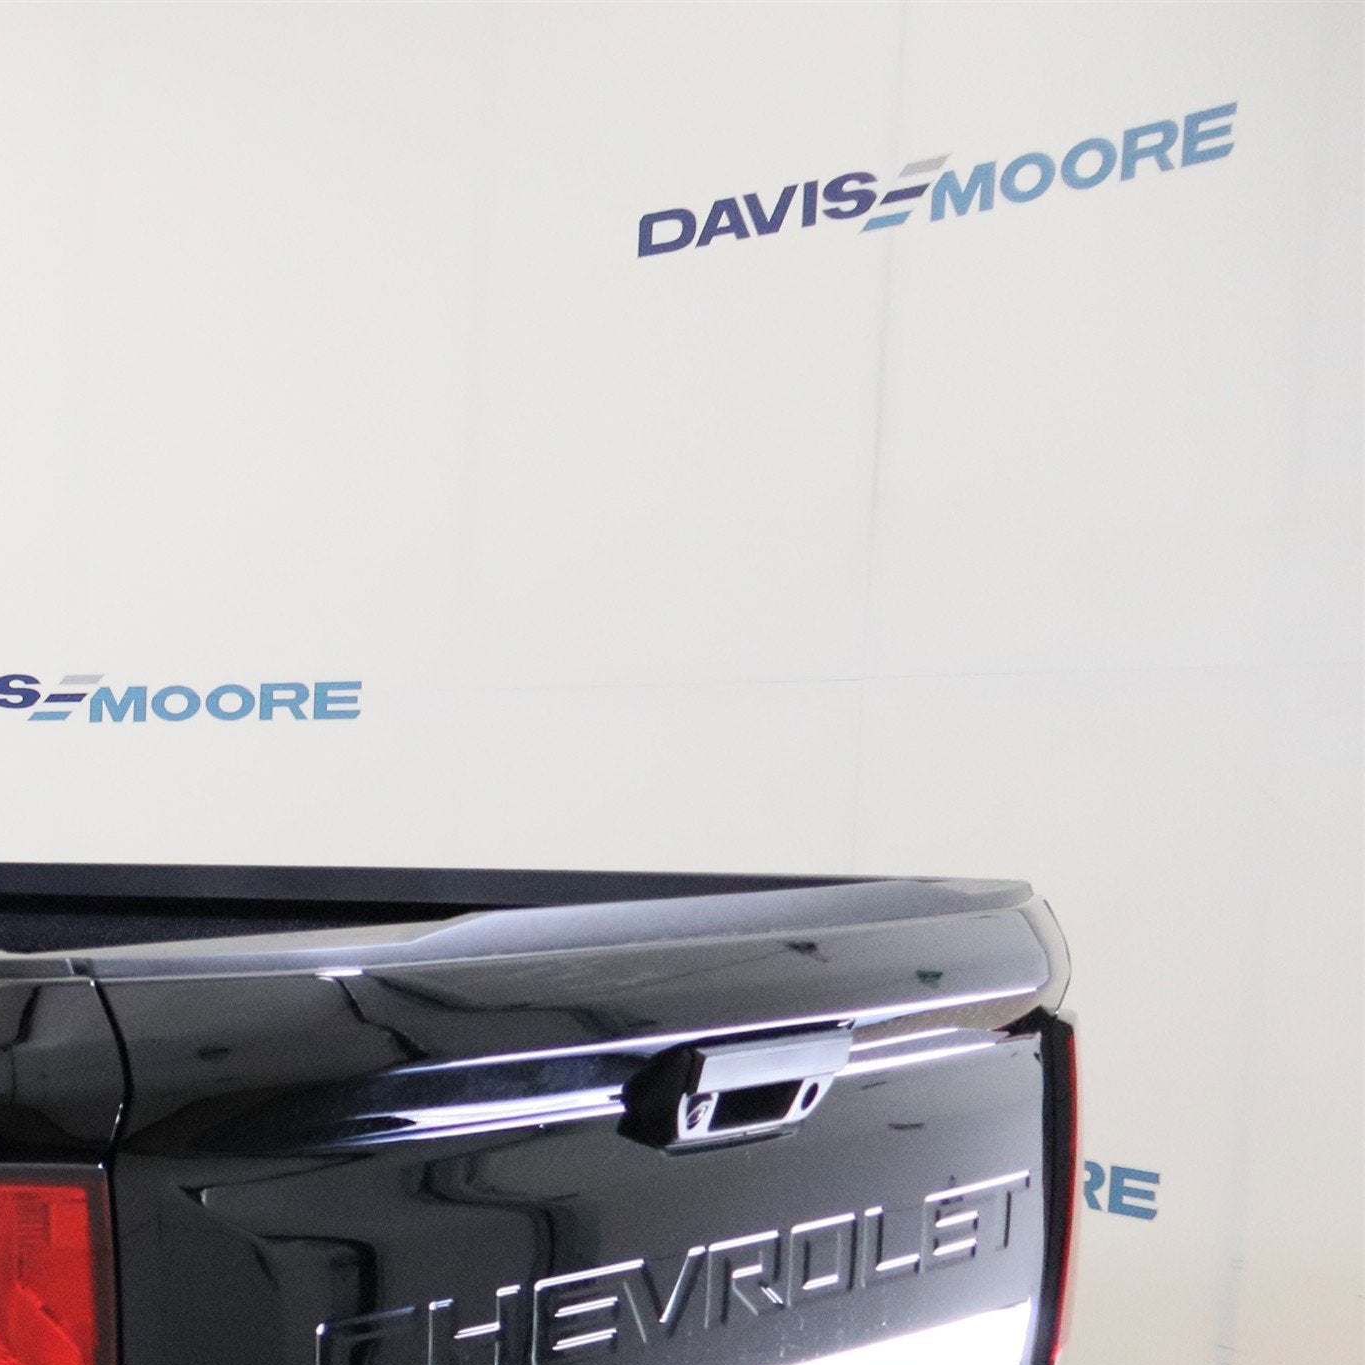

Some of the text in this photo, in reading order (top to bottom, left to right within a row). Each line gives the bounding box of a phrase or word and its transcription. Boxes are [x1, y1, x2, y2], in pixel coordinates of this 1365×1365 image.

[636, 102, 1239, 258] DAVIS MOORE
[87, 678, 364, 725] MOORE
